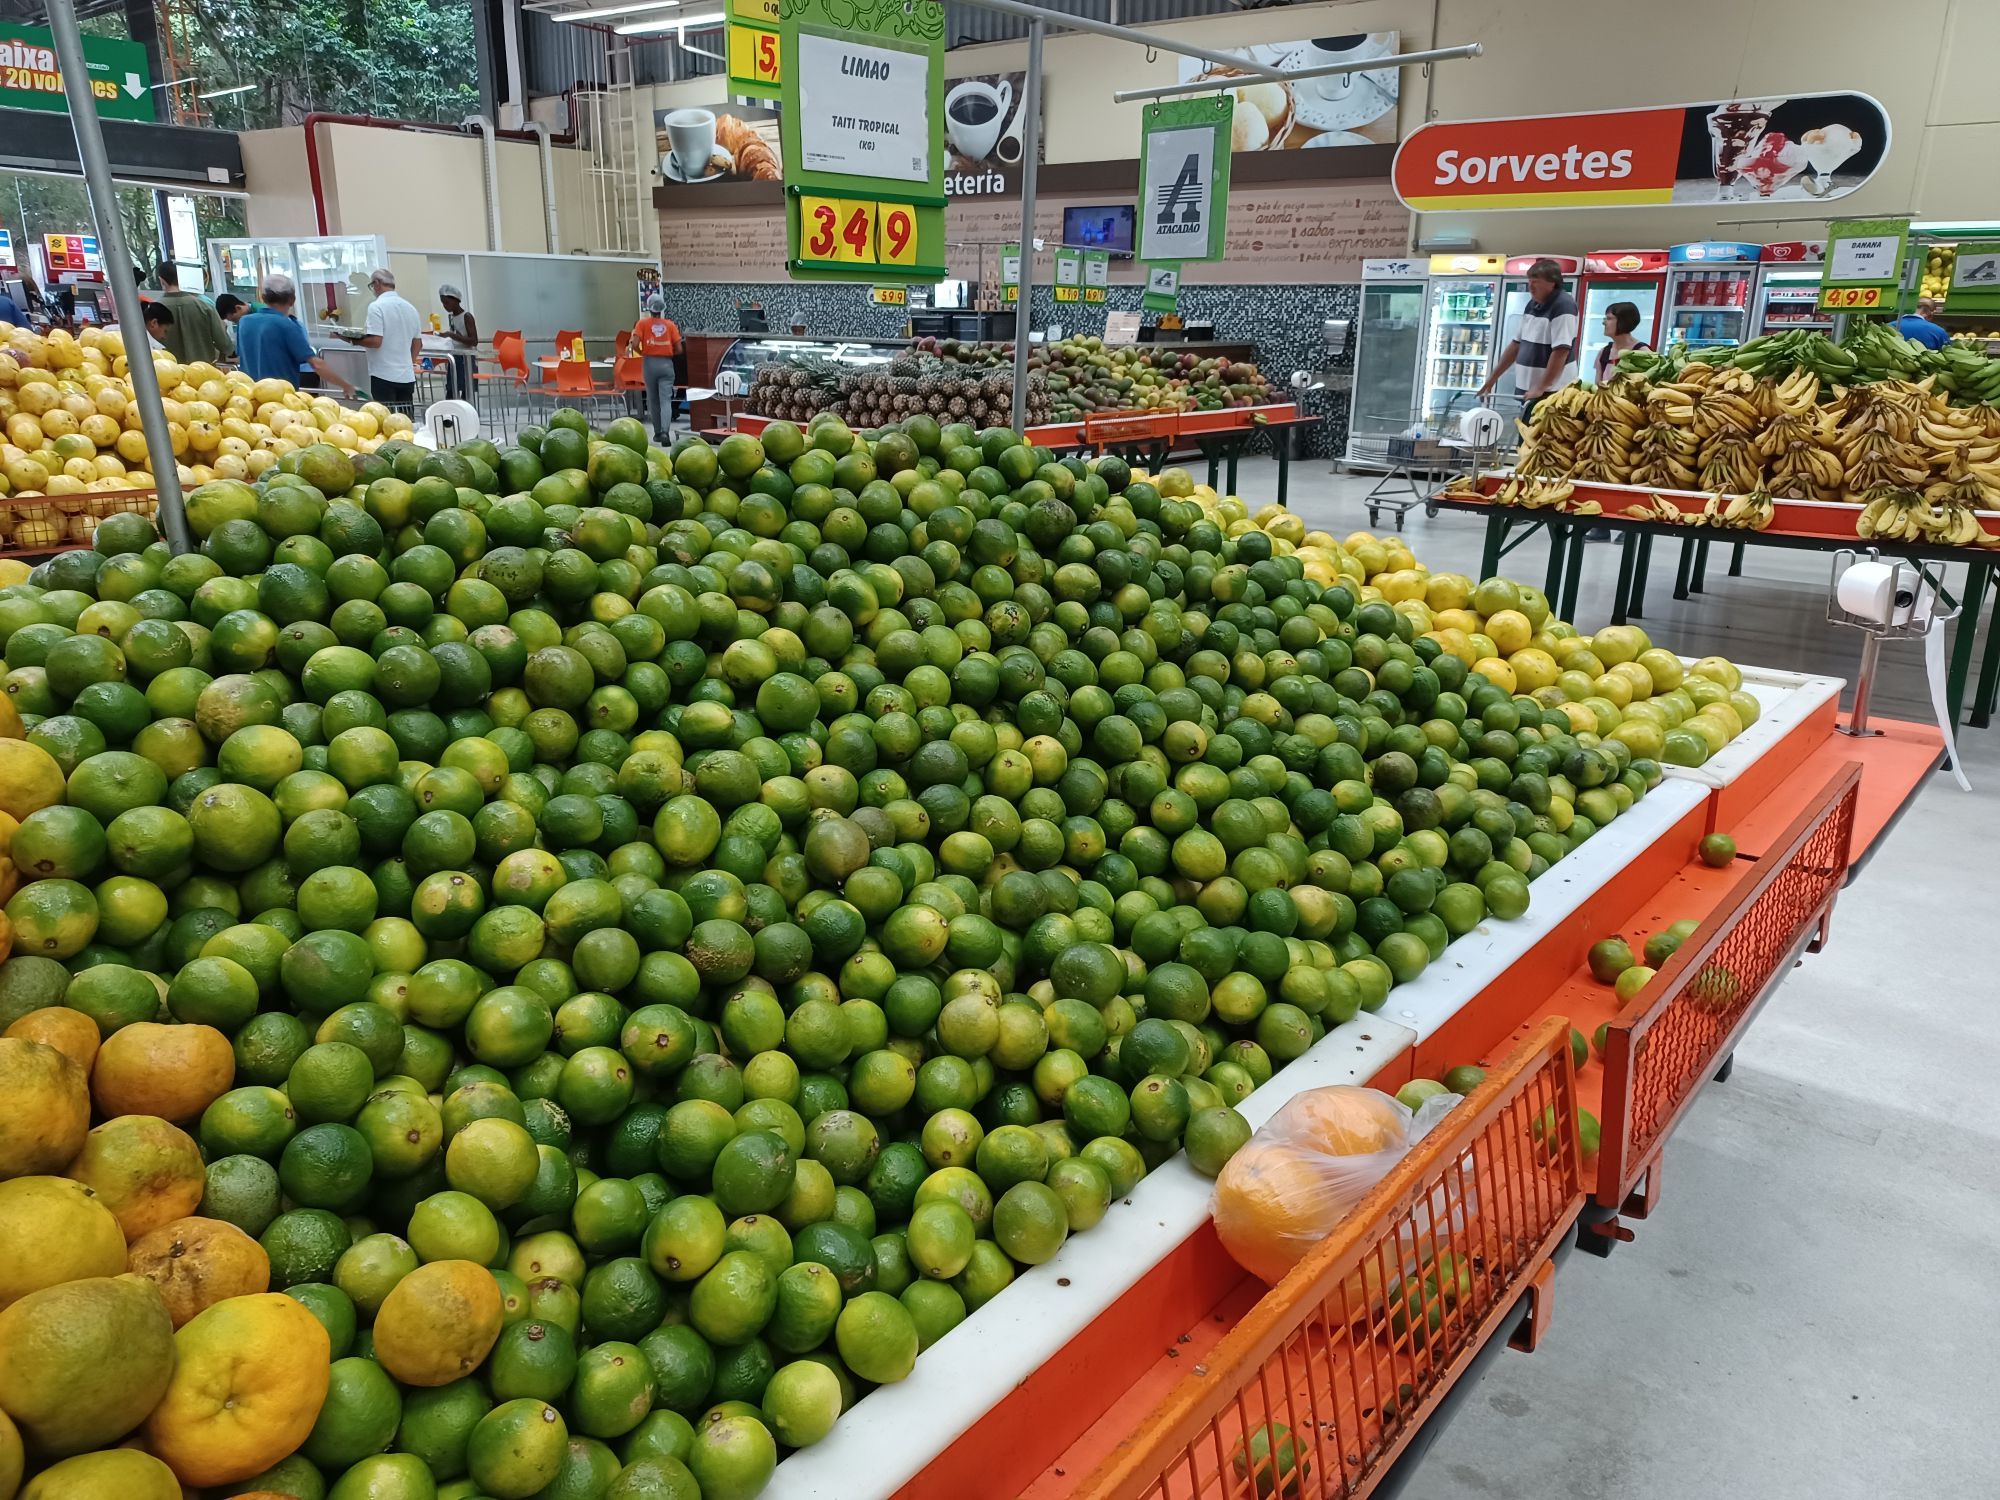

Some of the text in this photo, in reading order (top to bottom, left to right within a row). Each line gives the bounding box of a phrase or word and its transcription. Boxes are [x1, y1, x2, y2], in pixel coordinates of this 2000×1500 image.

[6, 68, 31, 90] 20
[841, 55, 890, 81] LIMAO
[832, 115, 900, 135] TAITI TROPICAL
[859, 140, 875, 151] (KG)
[1434, 144, 1633, 185] Sorvetes
[944, 169, 1005, 196] eteria
[1255, 213, 1293, 225] aroma
